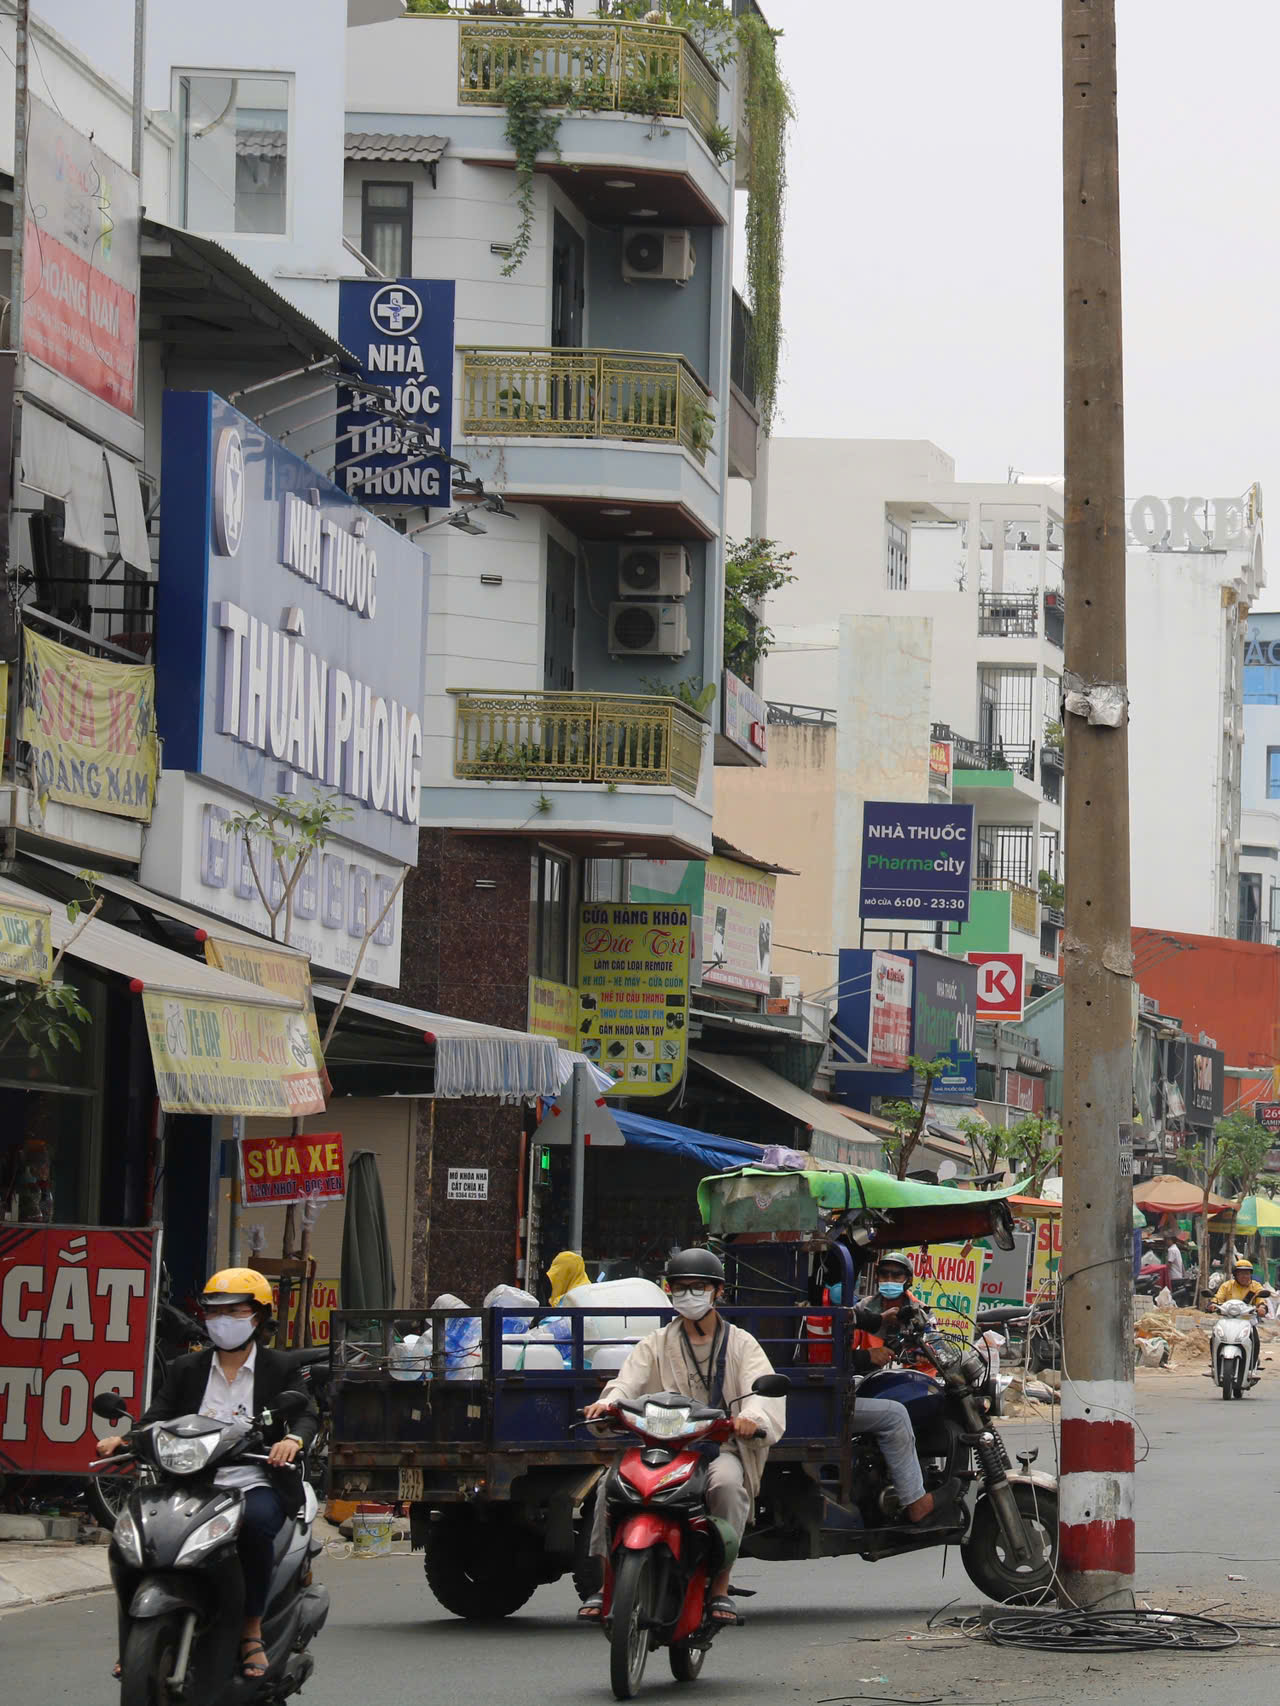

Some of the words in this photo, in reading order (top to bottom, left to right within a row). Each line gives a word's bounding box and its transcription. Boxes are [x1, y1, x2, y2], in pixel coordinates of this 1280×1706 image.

[90, 289, 119, 339] NAM
[367, 336, 425, 373] NHÀ
[346, 466, 440, 496] PHONG
[282, 487, 321, 585] NHÀ
[321, 516, 377, 620] THUỐC
[107, 687, 137, 756] XE
[219, 600, 328, 795] THUẬN
[327, 667, 422, 825] PHONG
[105, 766, 149, 808] NAM
[868, 822, 905, 839] NHÀ
[908, 822, 967, 841] THUỐC
[867, 852, 966, 876] Pharmacity
[613, 906, 648, 925] HÀNG
[653, 908, 687, 926] KHÓA
[894, 897, 921, 908] 6:00
[931, 898, 965, 910] 23:30
[584, 927, 634, 953] Đức
[643, 928, 686, 958] Trí
[645, 961, 673, 972] REMOTE
[247, 1139, 300, 1178] SỬA
[307, 1144, 340, 1173] XE
[250, 1183, 271, 1198] THAY
[2, 1235, 146, 1343] CẮT
[0, 1352, 136, 1443] TÓC
